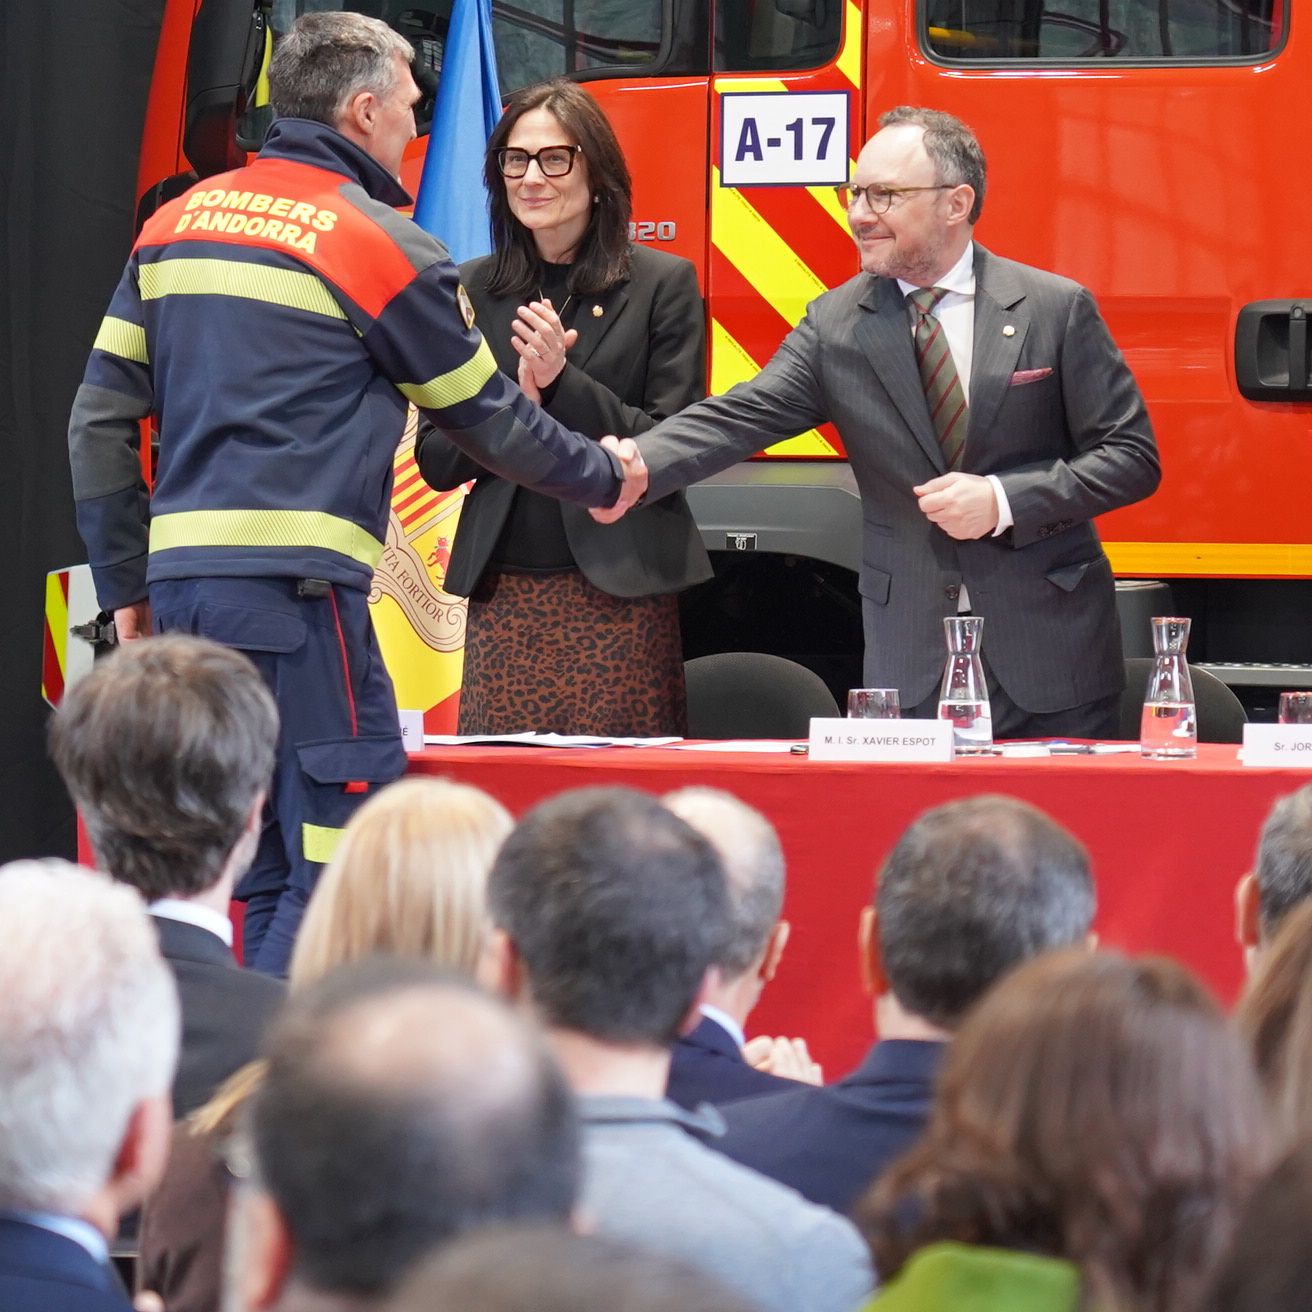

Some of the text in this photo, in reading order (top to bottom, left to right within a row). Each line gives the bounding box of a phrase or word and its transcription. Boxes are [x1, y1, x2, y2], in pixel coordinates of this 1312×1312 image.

[734, 117, 836, 162] A-17
[184, 189, 338, 232] BOMBERS
[174, 211, 319, 253] D'ANDORRA
[396, 570, 444, 622] FORTIOR
[824, 735, 836, 745] M.
[846, 736, 860, 745] Sr.
[862, 736, 900, 746] XAVIER
[902, 736, 937, 747] ESPOT
[1274, 742, 1287, 751] Sr.
